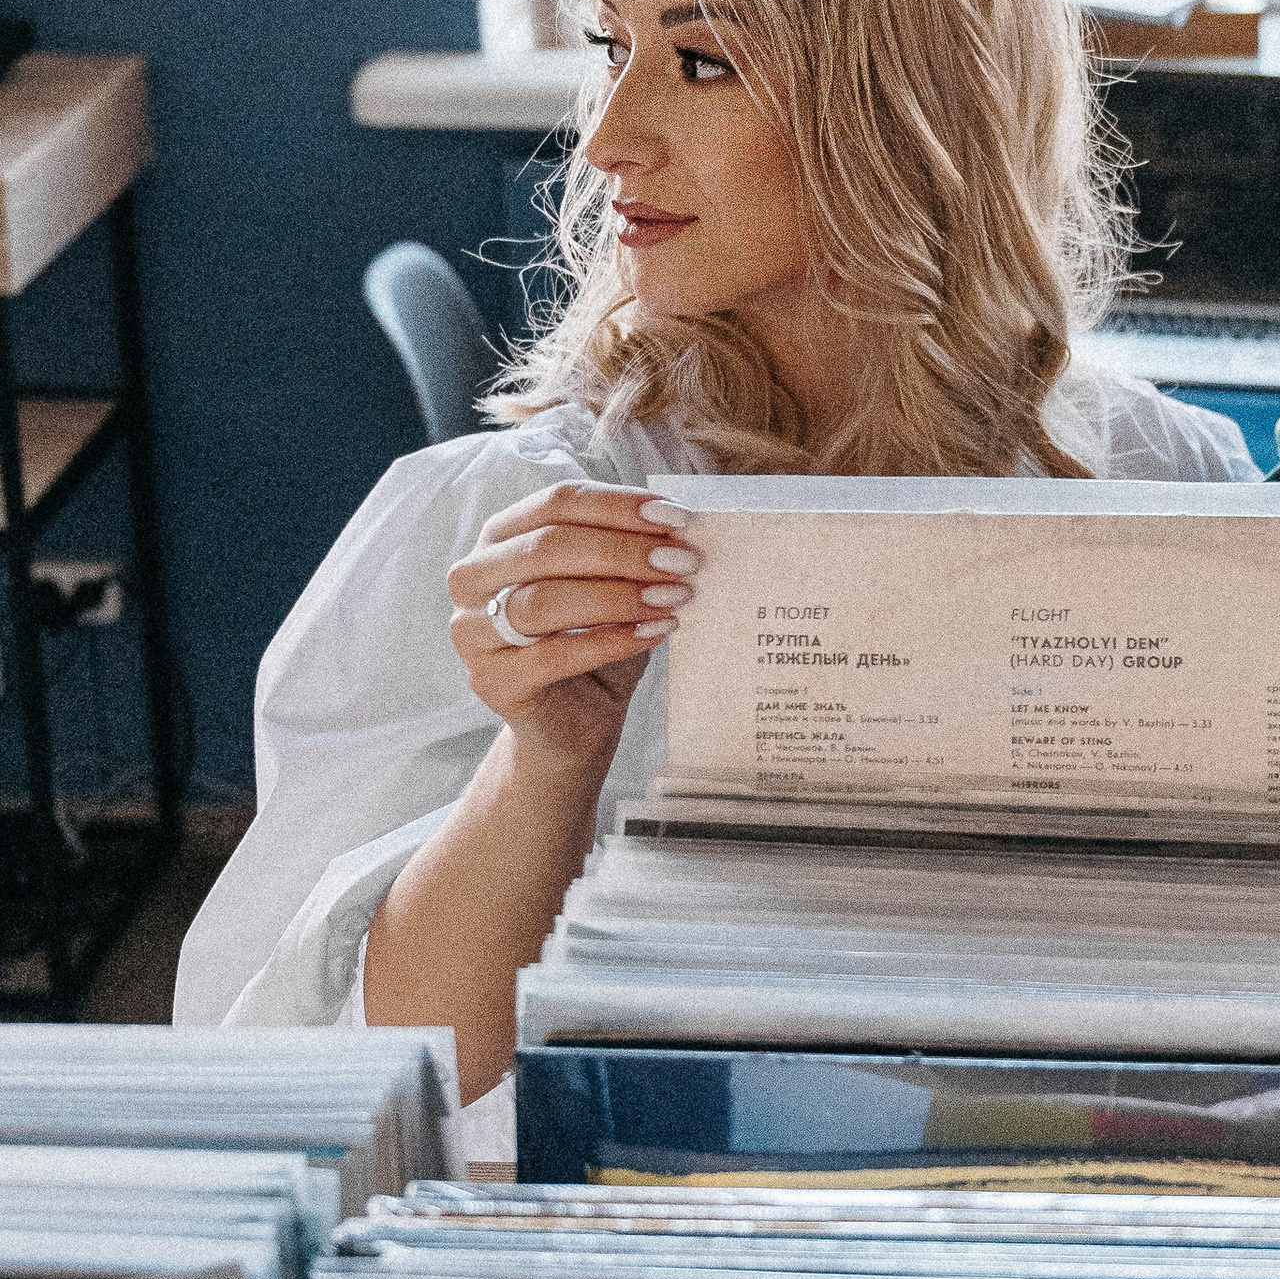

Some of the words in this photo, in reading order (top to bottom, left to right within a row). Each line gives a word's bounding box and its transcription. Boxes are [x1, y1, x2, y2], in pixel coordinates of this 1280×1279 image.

[757, 606, 767, 620] В
[1011, 608, 1071, 622] FLIGHT
[757, 634, 822, 646] ГРУППА
[856, 653, 910, 669] ДЕНЬ»
[1010, 654, 1063, 669] (HARD
[1072, 654, 1114, 671] DAY)
[1122, 656, 1183, 669] GROUP
[756, 686, 799, 695] Сторона
[1011, 688, 1033, 696] Side
[756, 702, 780, 711] ДАЙ
[785, 702, 807, 711] МНЕ
[813, 703, 847, 711] ЗНАТЬ
[1011, 705, 1028, 714] LET
[1034, 705, 1049, 714] ME
[1054, 705, 1090, 714] KNOW
[919, 714, 939, 724] 3.33
[1011, 717, 1042, 727] (music
[1047, 718, 1065, 727] and
[1070, 719, 1101, 728] words
[1105, 719, 1118, 729] by
[1192, 719, 1212, 729] 3.33
[756, 731, 806, 740] БЕРЕГИСЬ
[812, 732, 845, 741] ЖАЛА
[1011, 736, 1055, 745] BEWARE
[1061, 737, 1075, 745] OF
[1080, 737, 1112, 746] STING
[1011, 781, 1060, 790] MIRRORS
